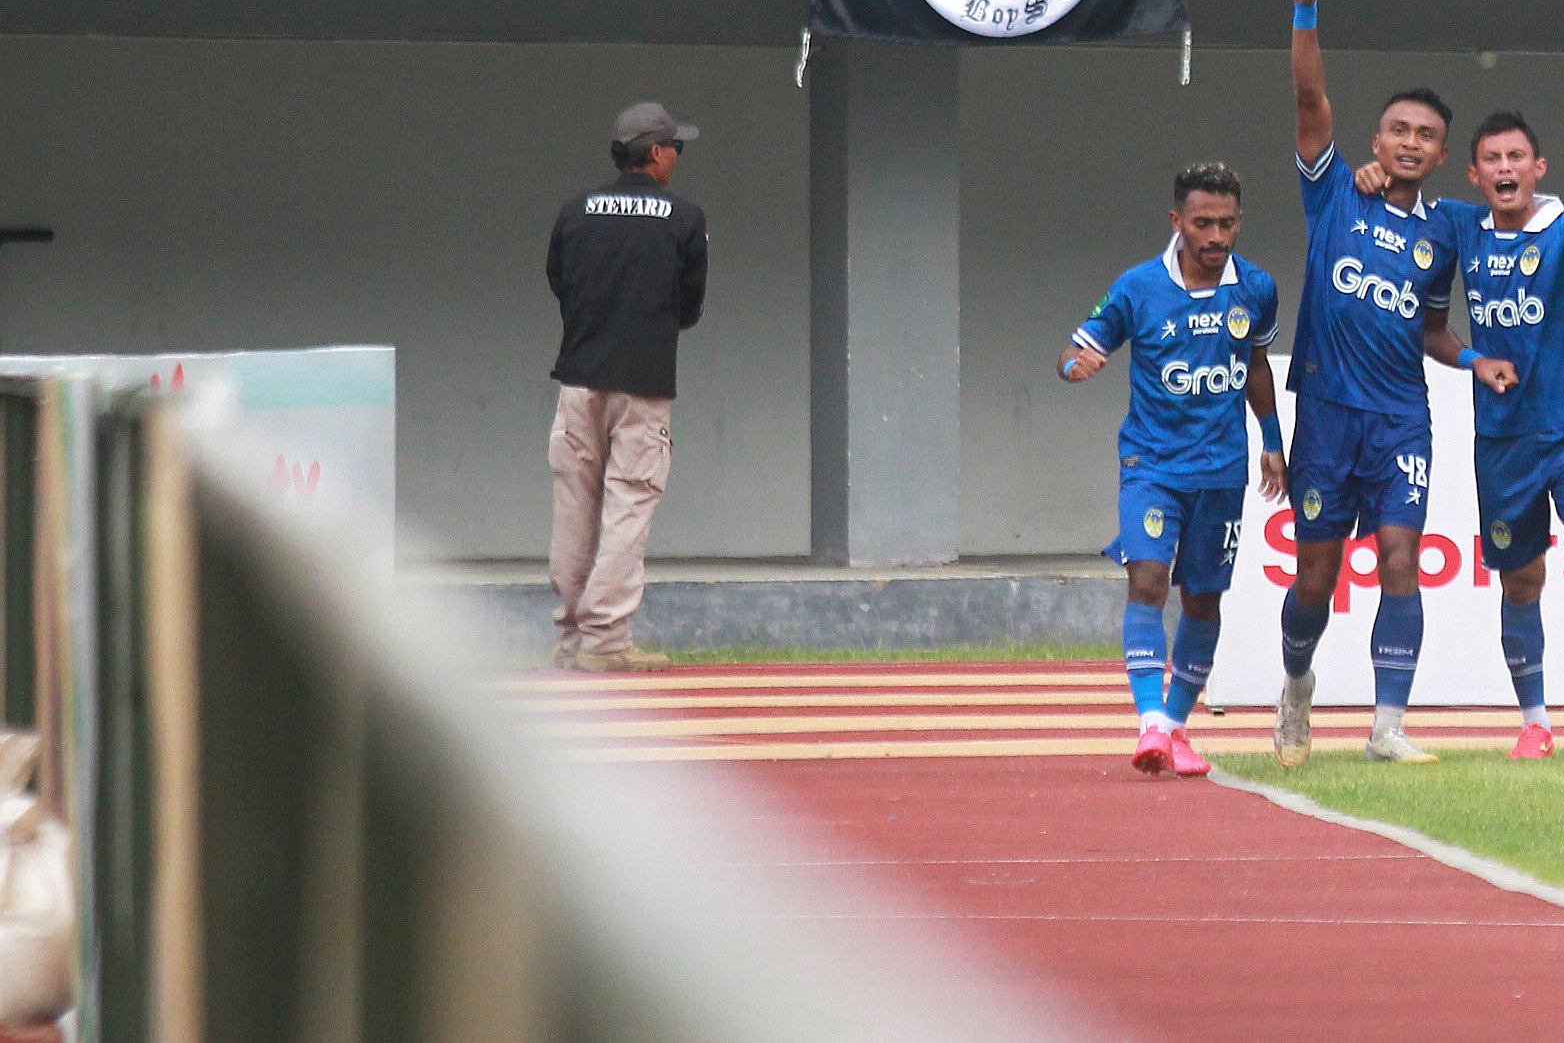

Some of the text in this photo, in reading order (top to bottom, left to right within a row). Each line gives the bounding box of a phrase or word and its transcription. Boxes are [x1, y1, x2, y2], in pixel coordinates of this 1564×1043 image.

[586, 195, 674, 218] STEWARD
[1373, 225, 1407, 251] nex
[1487, 254, 1517, 270] nex
[1332, 256, 1420, 319] Grab
[1188, 312, 1225, 329] nex
[1467, 287, 1545, 328] Grab
[1161, 353, 1248, 395] Grab
[1396, 455, 1428, 488] 48
